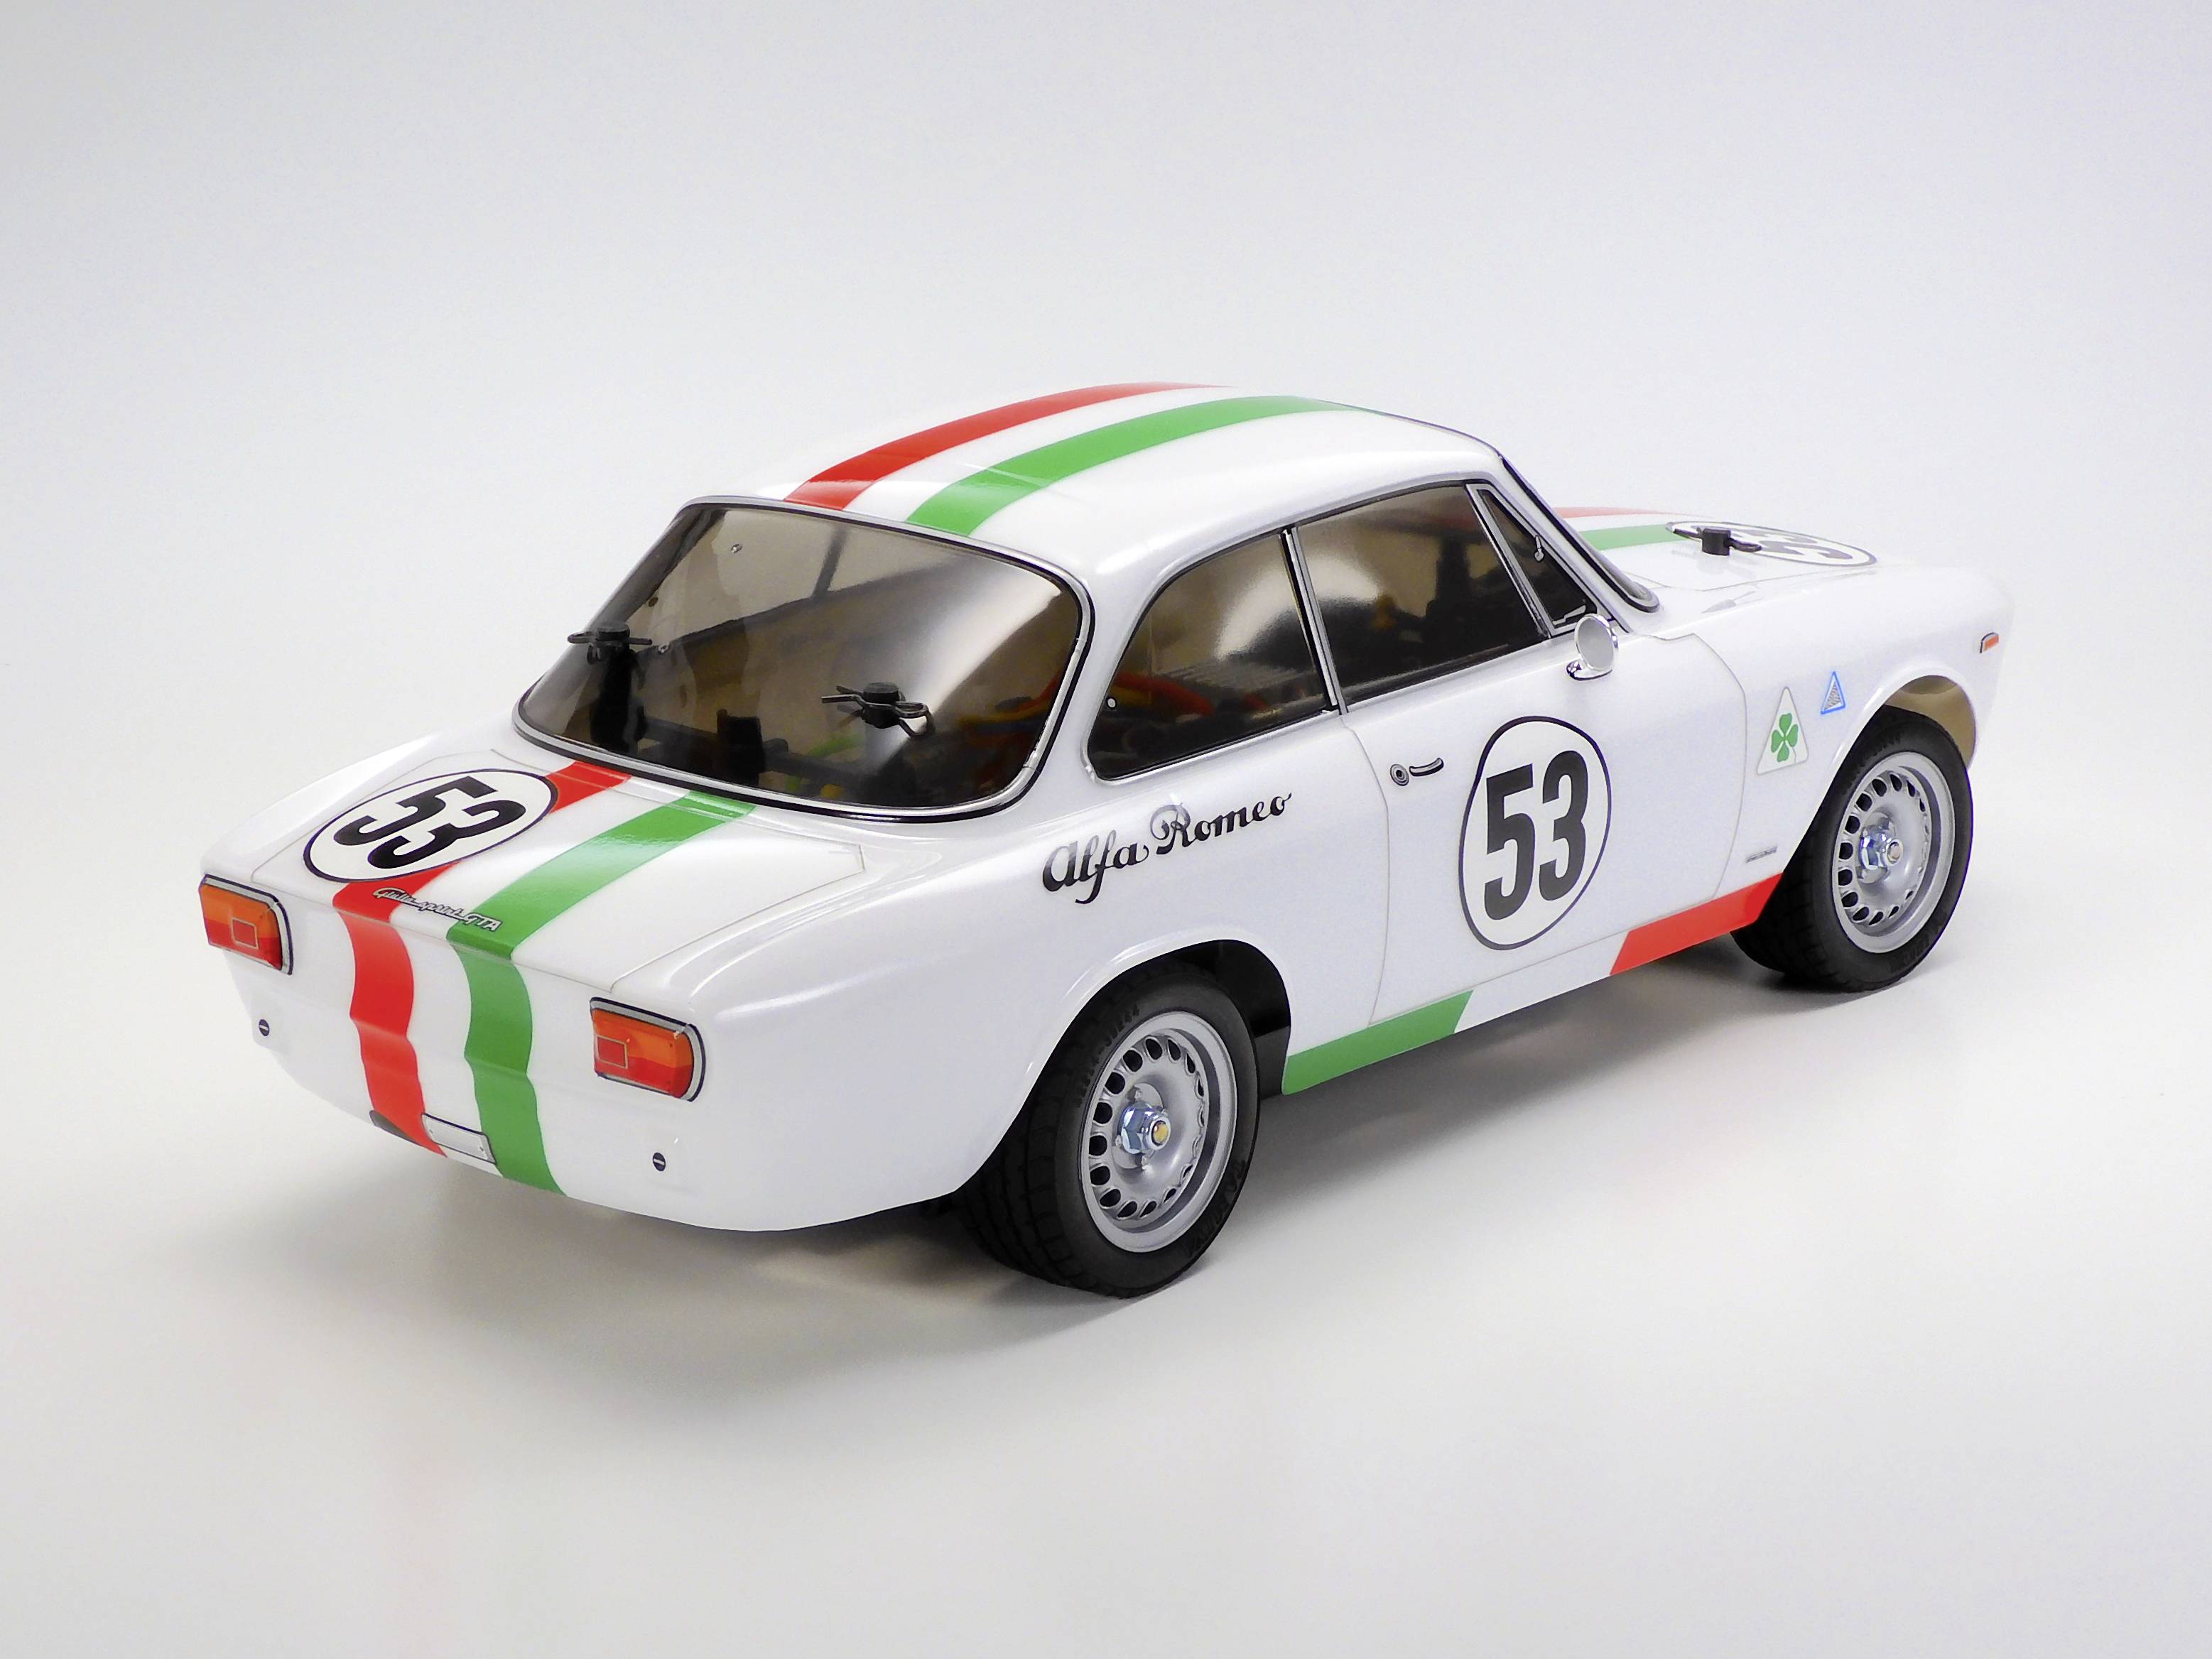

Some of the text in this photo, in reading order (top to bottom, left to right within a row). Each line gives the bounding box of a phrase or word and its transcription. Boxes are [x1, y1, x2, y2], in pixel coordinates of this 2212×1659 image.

[333, 776, 526, 869] 53
[1042, 792, 1292, 905] Alfa Romeo
[1484, 750, 1589, 920] 53
[462, 911, 503, 932] GTA
